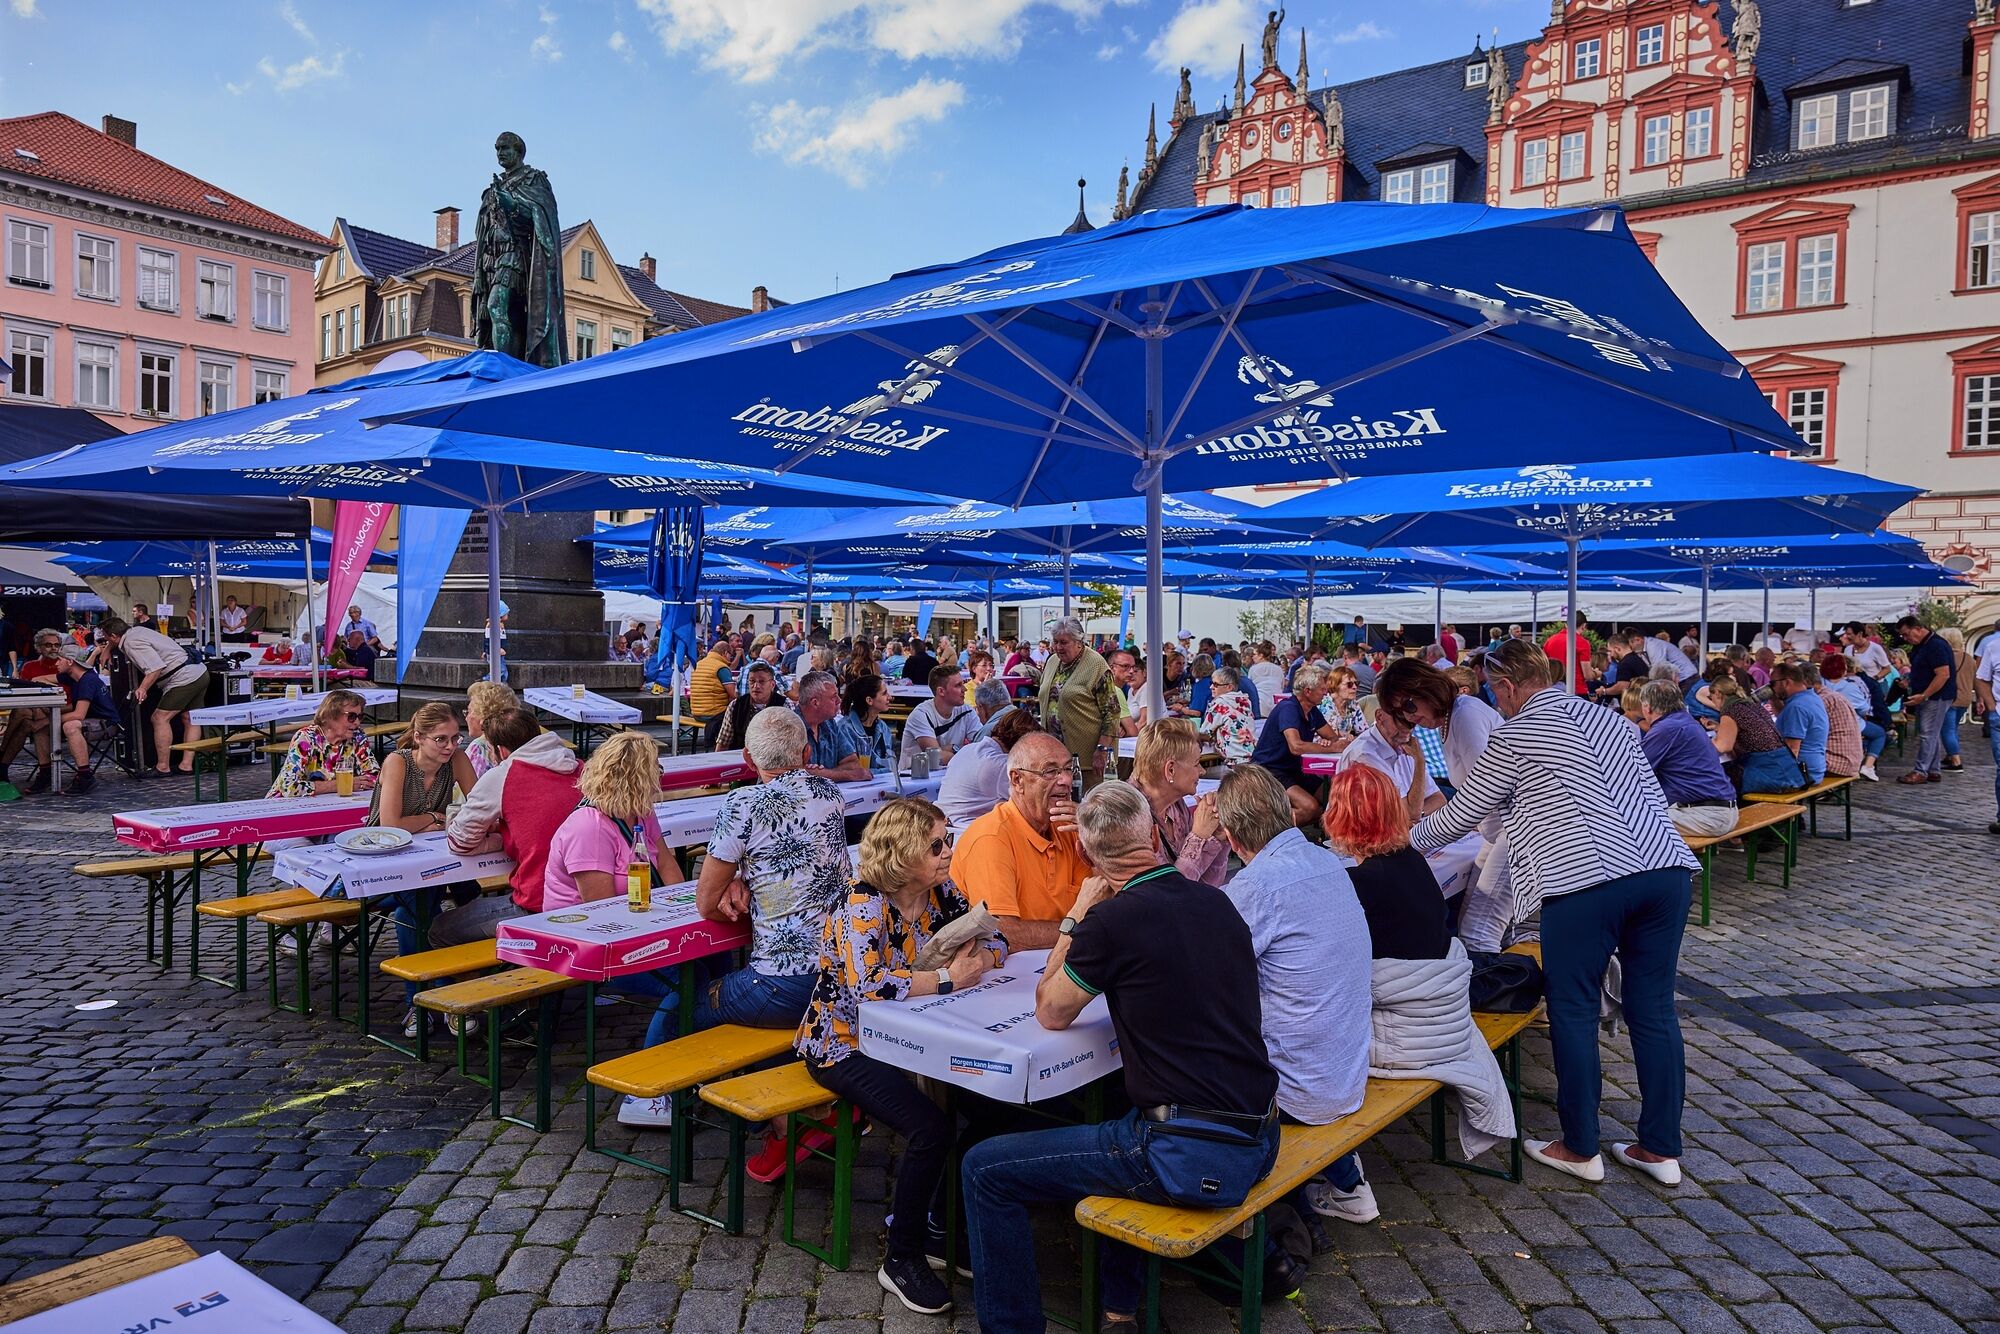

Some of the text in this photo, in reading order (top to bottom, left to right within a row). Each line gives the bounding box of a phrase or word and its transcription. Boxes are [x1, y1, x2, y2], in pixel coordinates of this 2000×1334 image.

[1446, 477, 1653, 497] Kaiserdom
[1464, 488, 1541, 499] BAMBERGER
[355, 517, 375, 549] NOCH
[4, 586, 56, 596] 24MX
[360, 876, 383, 885] VR-Bank
[910, 982, 1000, 1013] VR-Bank Coburg
[1004, 1011, 1036, 1024] VR-Ba
[874, 1030, 925, 1055] VR-Bank Coburg
[951, 1057, 973, 1067] Morgen
[973, 1060, 987, 1069] kann
[1052, 1050, 1094, 1074] VR-Bank Coburg
[122, 1317, 173, 1334] VR
